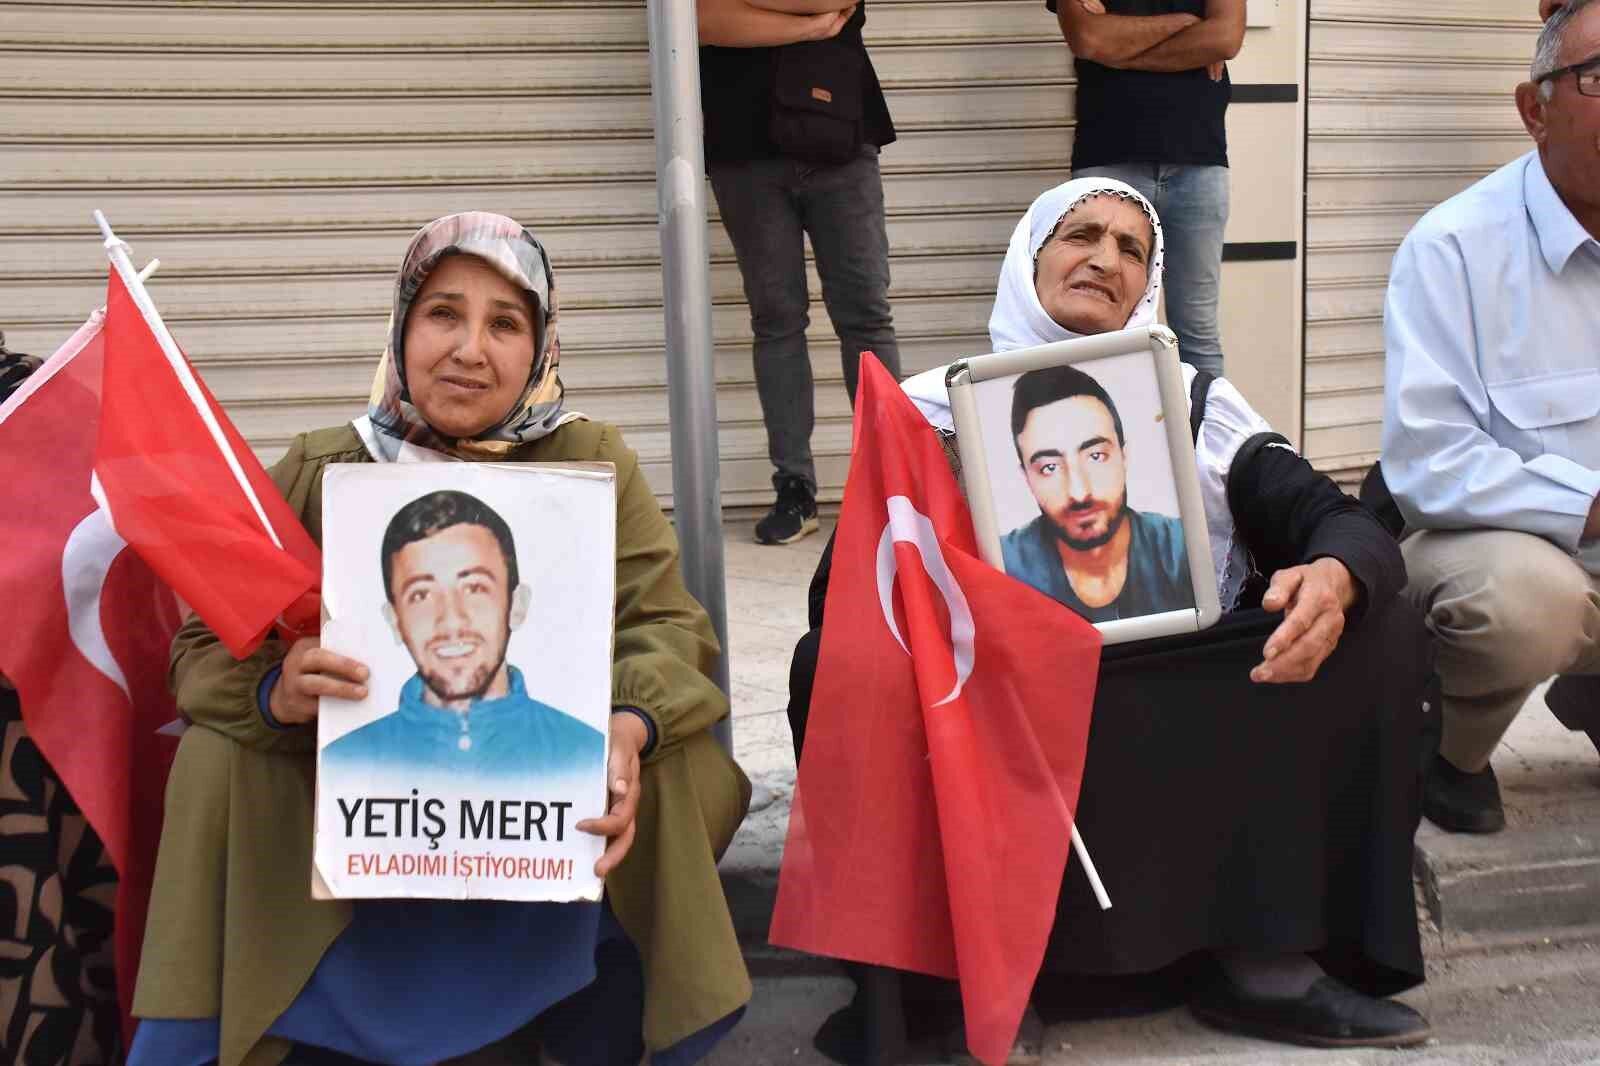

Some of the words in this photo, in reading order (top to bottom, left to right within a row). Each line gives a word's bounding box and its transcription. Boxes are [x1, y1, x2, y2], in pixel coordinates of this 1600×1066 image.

[338, 789, 446, 849] YETİŞ
[460, 800, 572, 841] MERT
[348, 854, 447, 876] EVLADIMI
